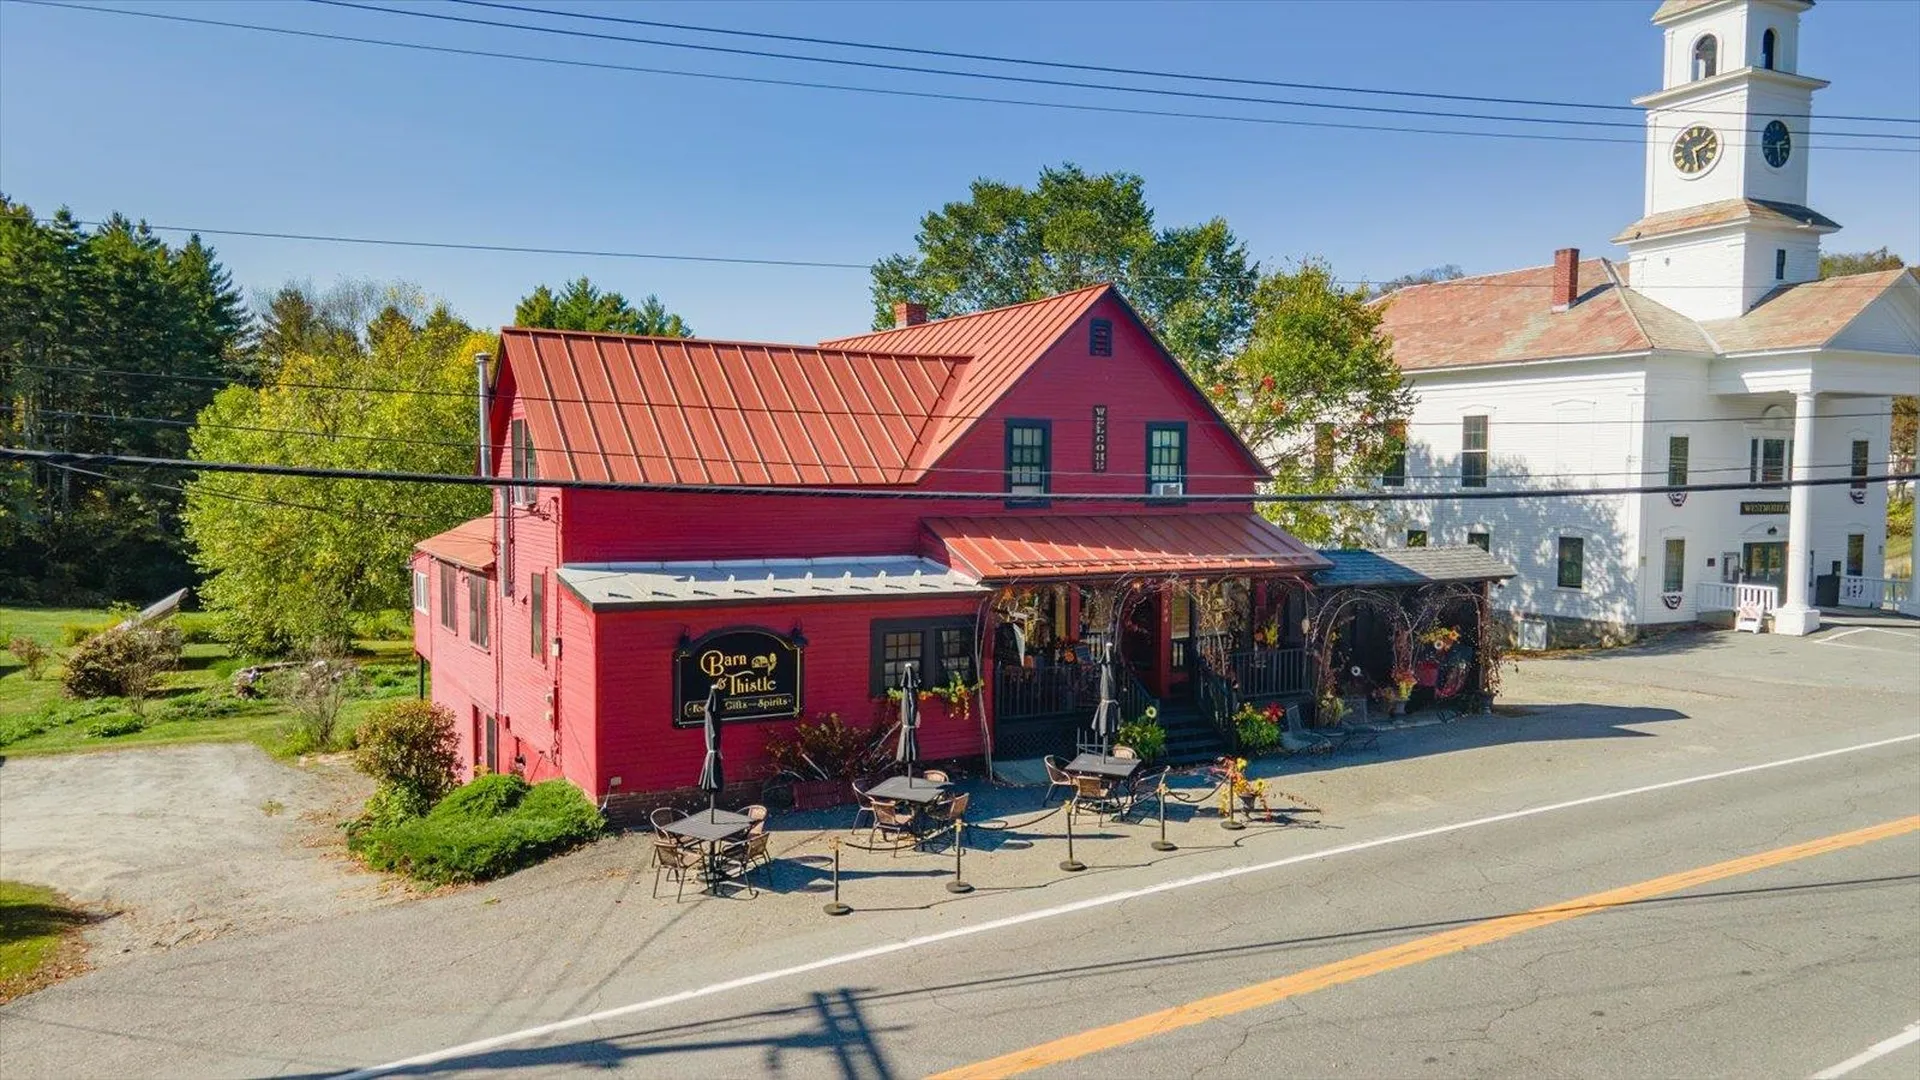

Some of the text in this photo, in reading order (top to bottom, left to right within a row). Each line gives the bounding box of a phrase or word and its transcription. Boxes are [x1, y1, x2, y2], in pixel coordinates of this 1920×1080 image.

[1095, 407, 1105, 470] WELCOME
[700, 650, 747, 676] Barn
[725, 671, 777, 695] Thistle
